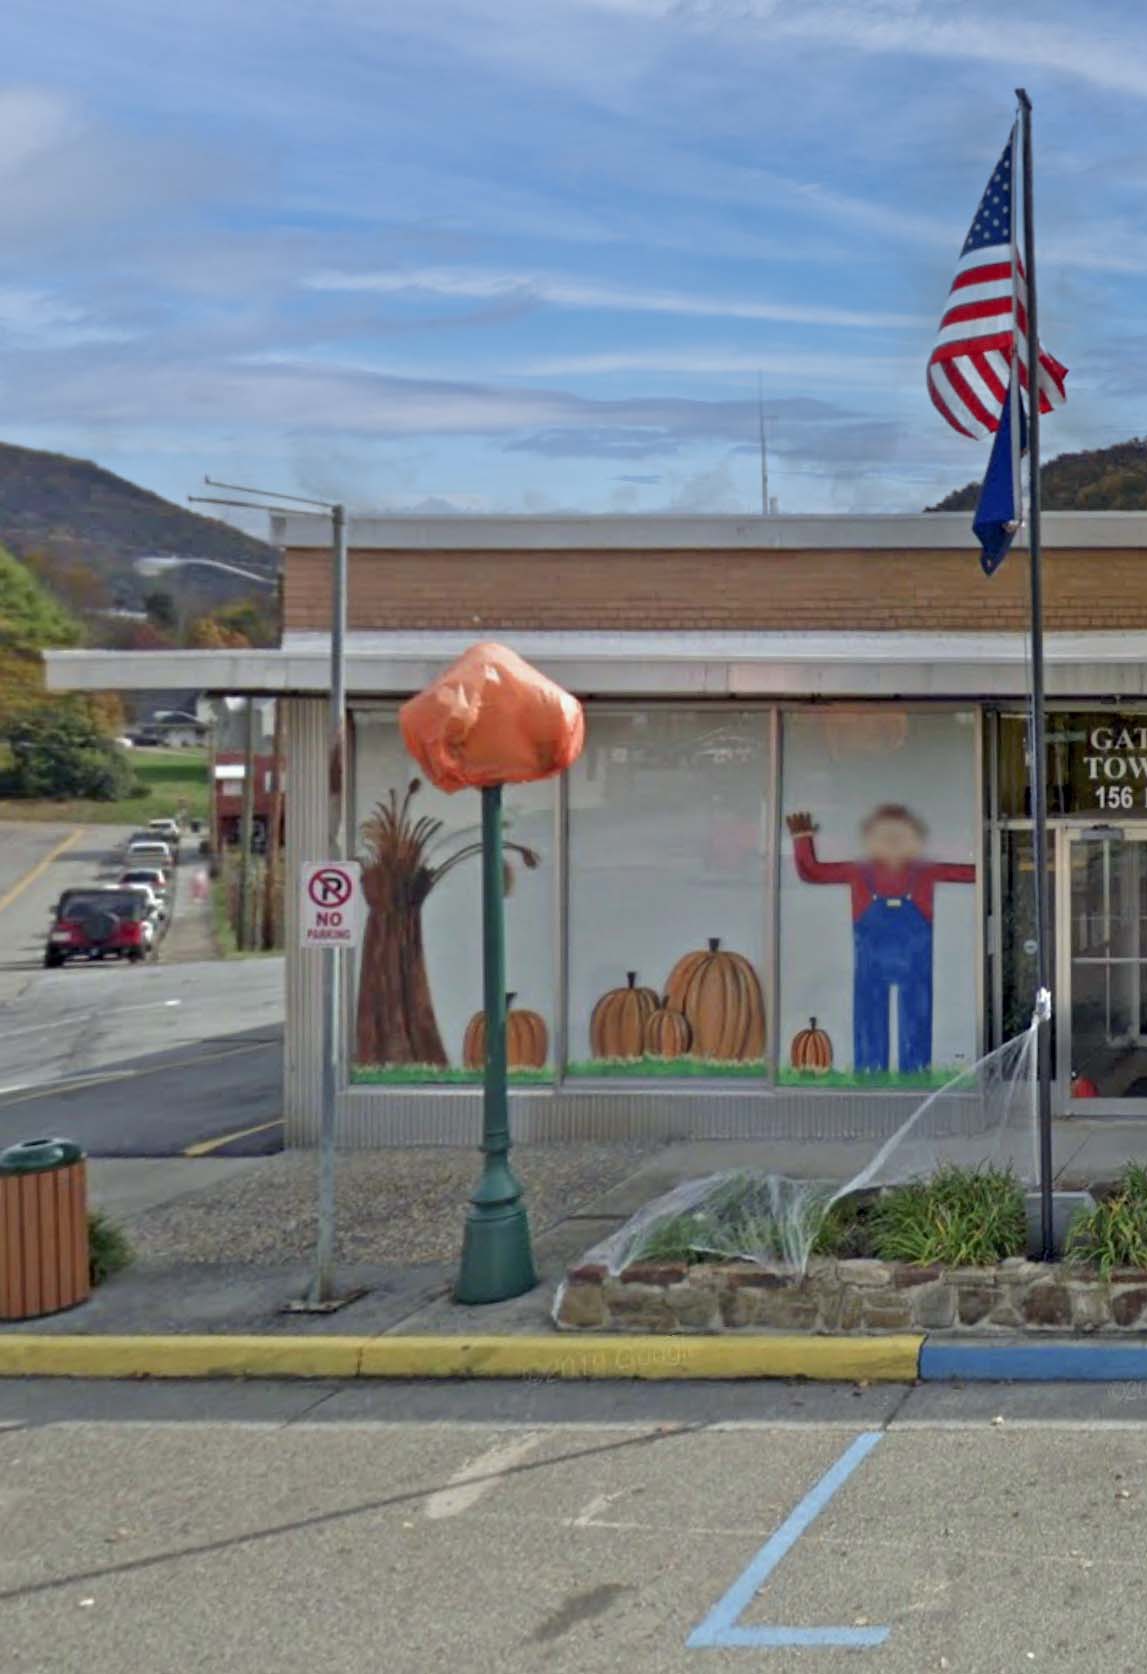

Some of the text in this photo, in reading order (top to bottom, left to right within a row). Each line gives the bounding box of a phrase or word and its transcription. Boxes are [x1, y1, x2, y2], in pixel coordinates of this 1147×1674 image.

[1096, 786, 1133, 808] 156
[316, 912, 342, 927] NO
[307, 929, 351, 939] PARKING
